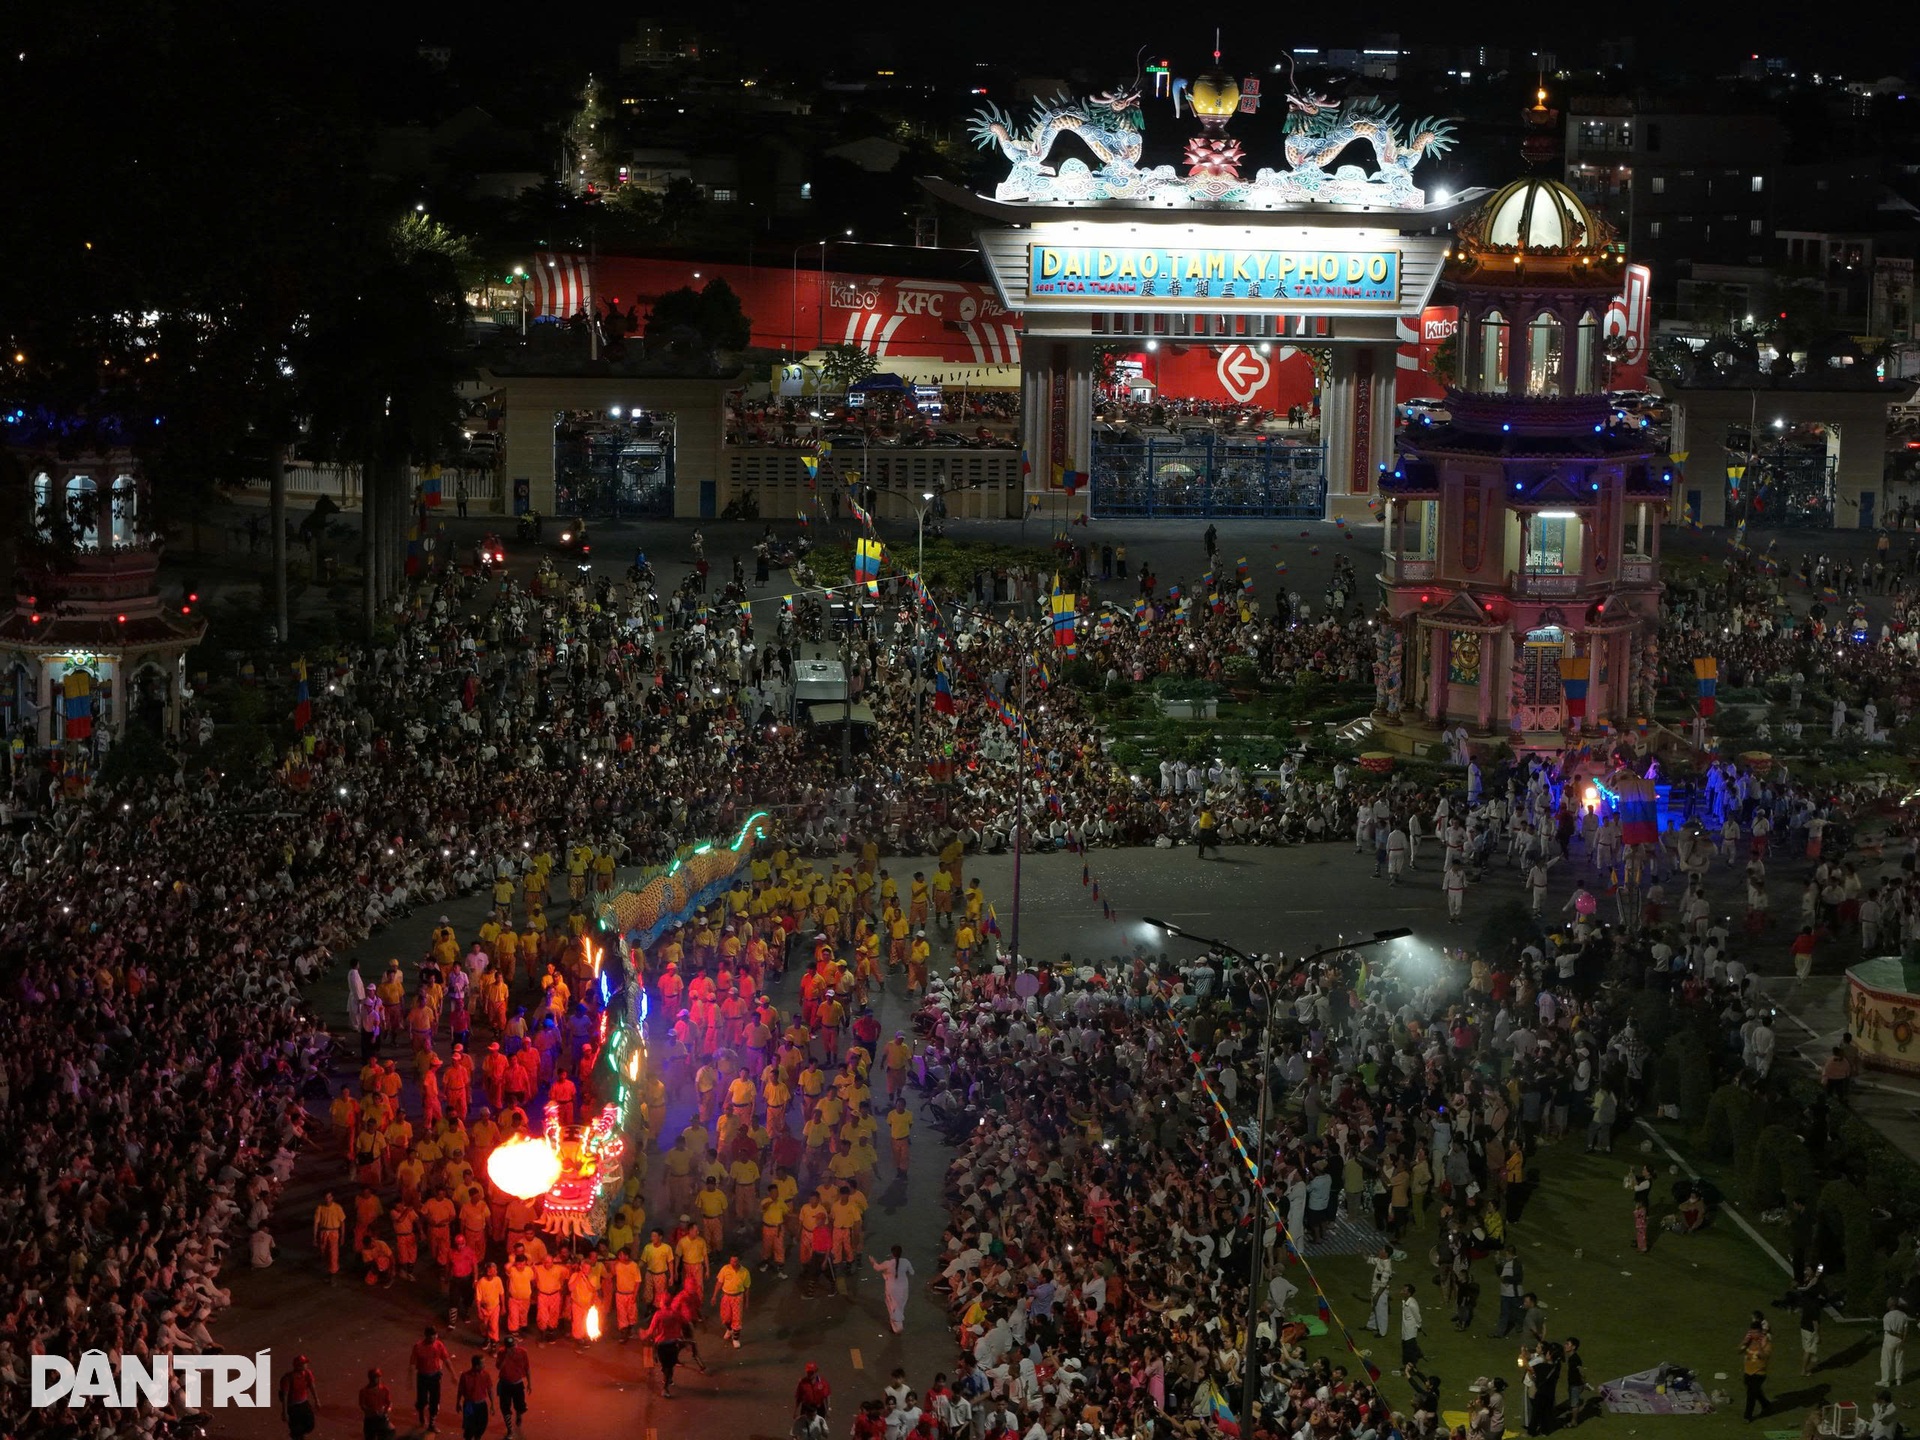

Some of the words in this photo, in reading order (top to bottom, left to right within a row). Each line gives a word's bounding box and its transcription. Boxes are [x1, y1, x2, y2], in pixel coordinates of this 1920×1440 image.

[1166, 251, 1225, 281] TAM
[1233, 252, 1273, 282] KY
[1278, 253, 1340, 284] PHO
[1090, 282, 1136, 294] THANH
[1294, 285, 1322, 297] TAY
[1325, 286, 1362, 298] NINH
[896, 291, 943, 317] KFC
